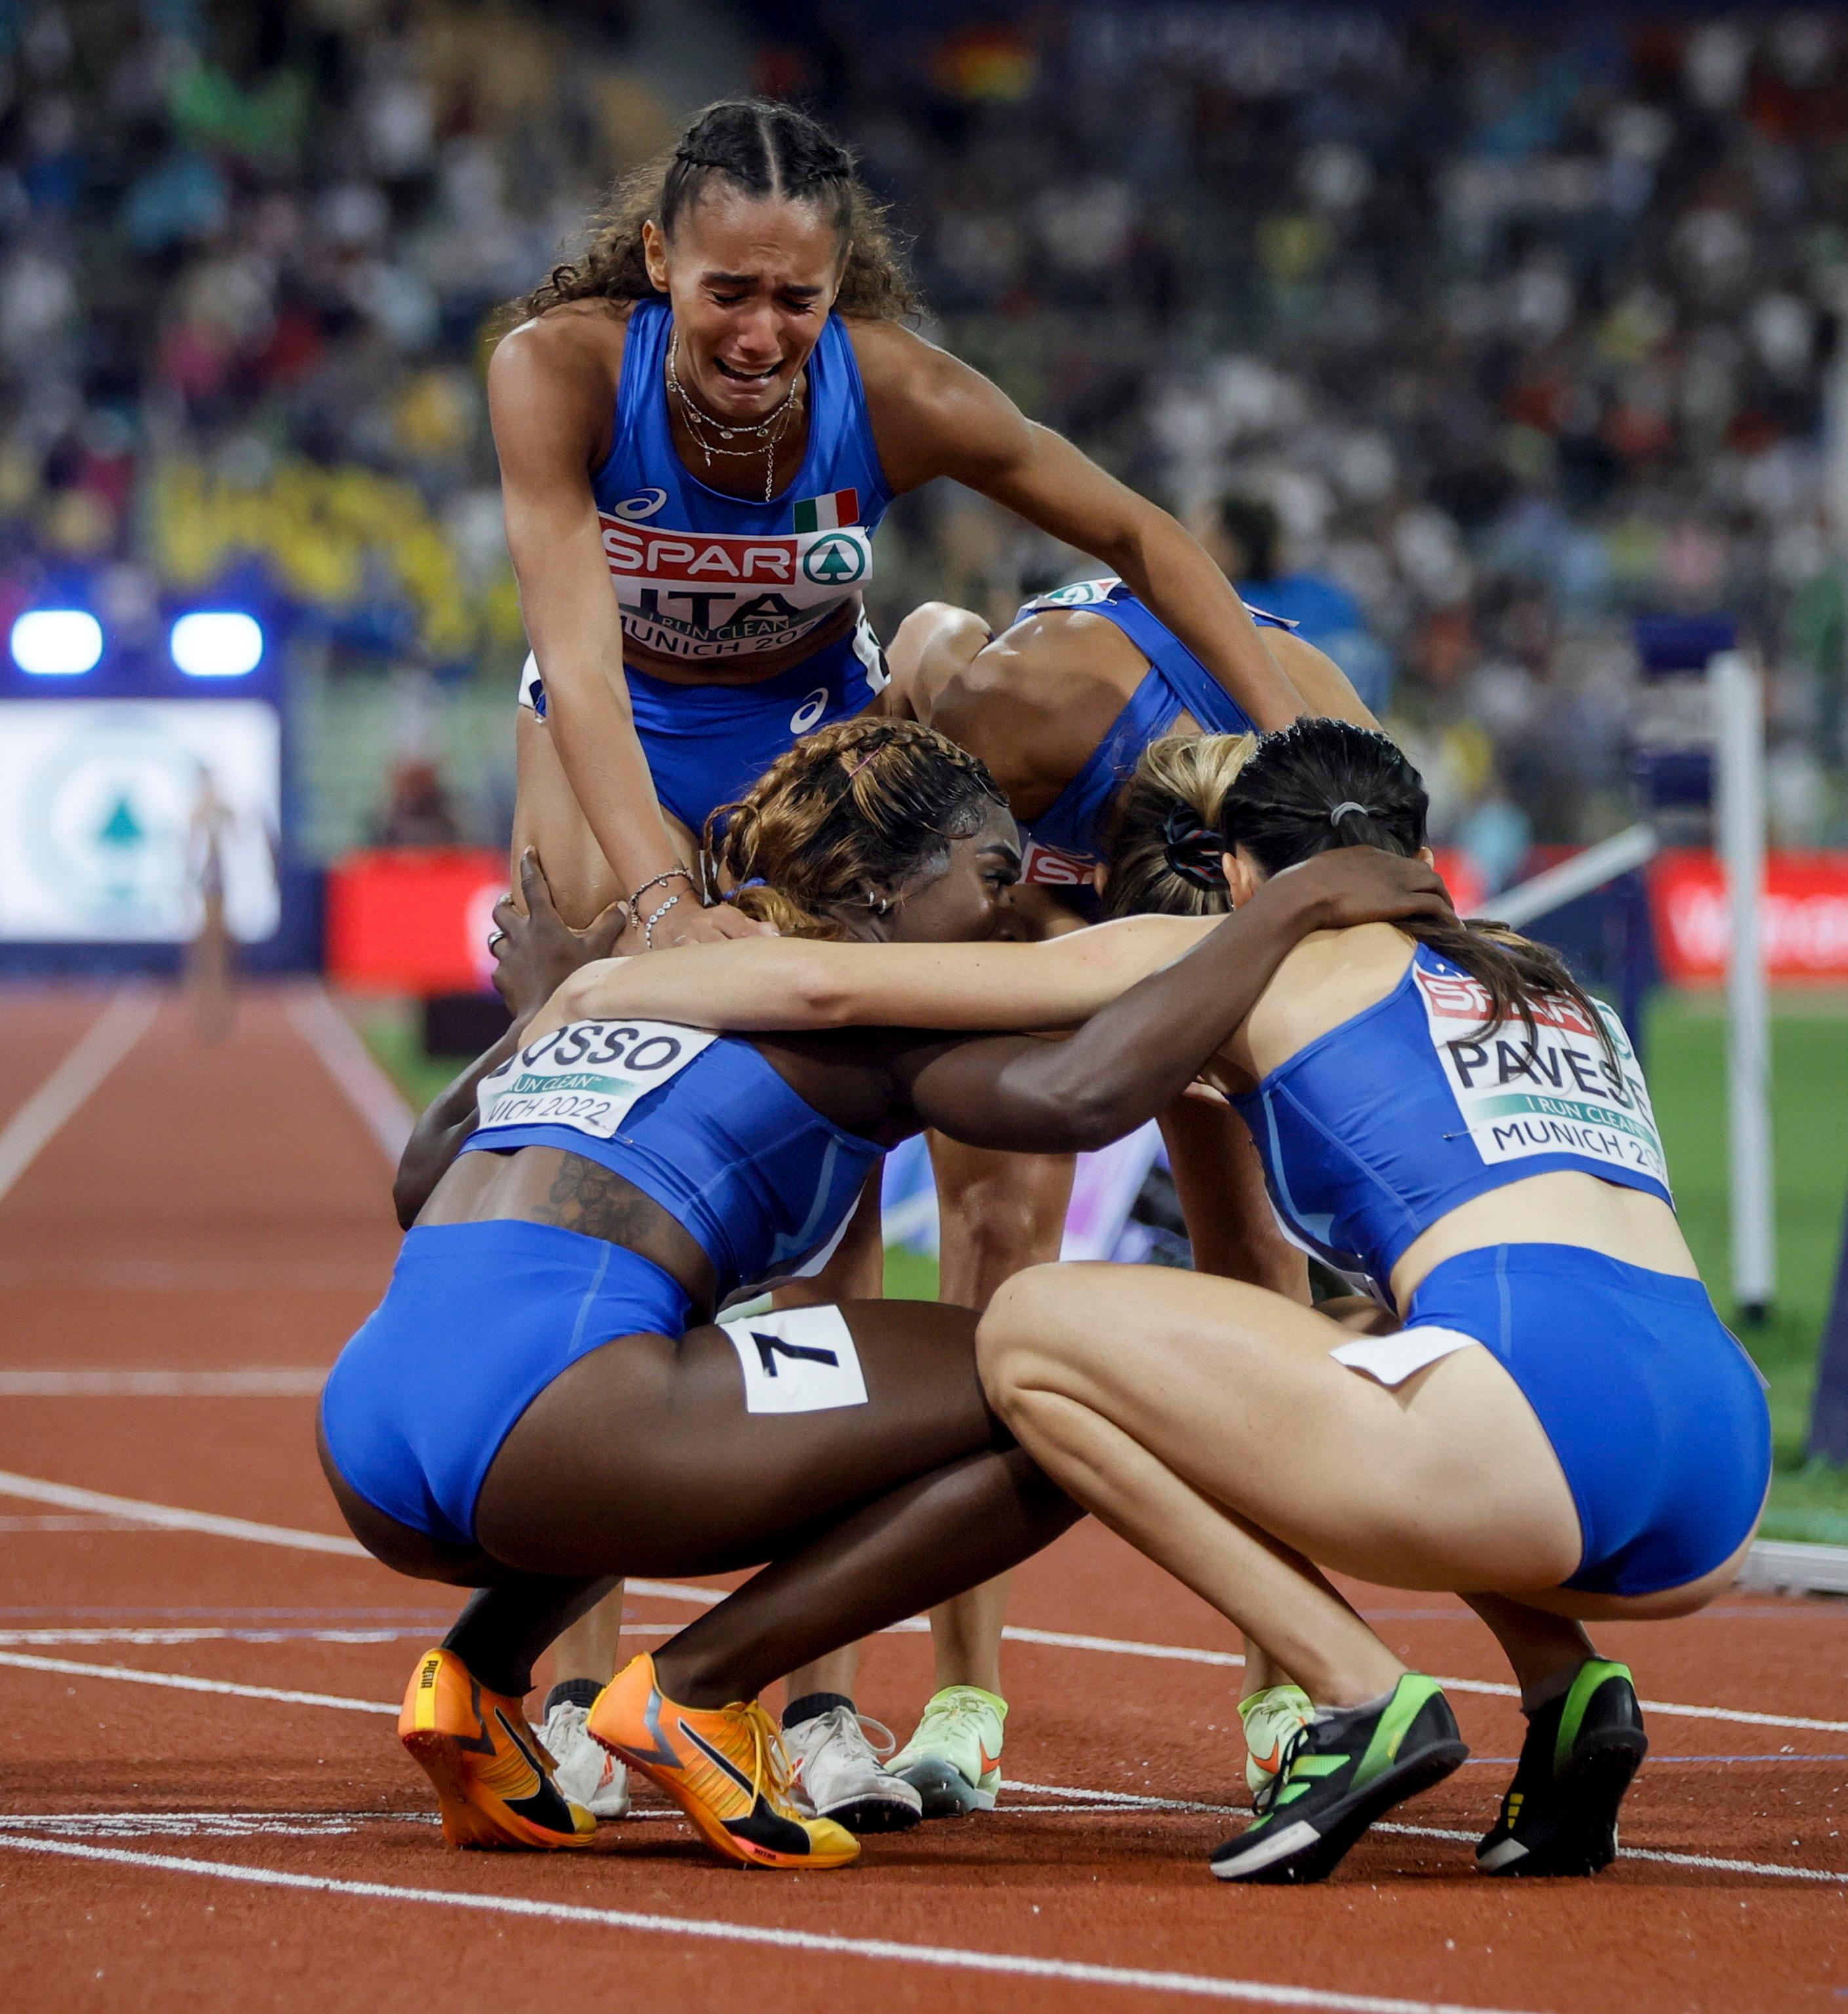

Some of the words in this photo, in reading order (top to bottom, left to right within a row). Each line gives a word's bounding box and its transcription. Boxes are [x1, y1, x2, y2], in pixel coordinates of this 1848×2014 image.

[602, 528, 791, 579] SPAR
[640, 588, 802, 631] ITA
[661, 618, 709, 641] RUN
[488, 1025, 682, 1079] OSSO
[539, 1096, 612, 1126] 2022
[1541, 1097, 1583, 1120] RUN
[1492, 1120, 1624, 1159] MUNICH
[1630, 1141, 1664, 1177] 20
[750, 1331, 840, 1378] 7
